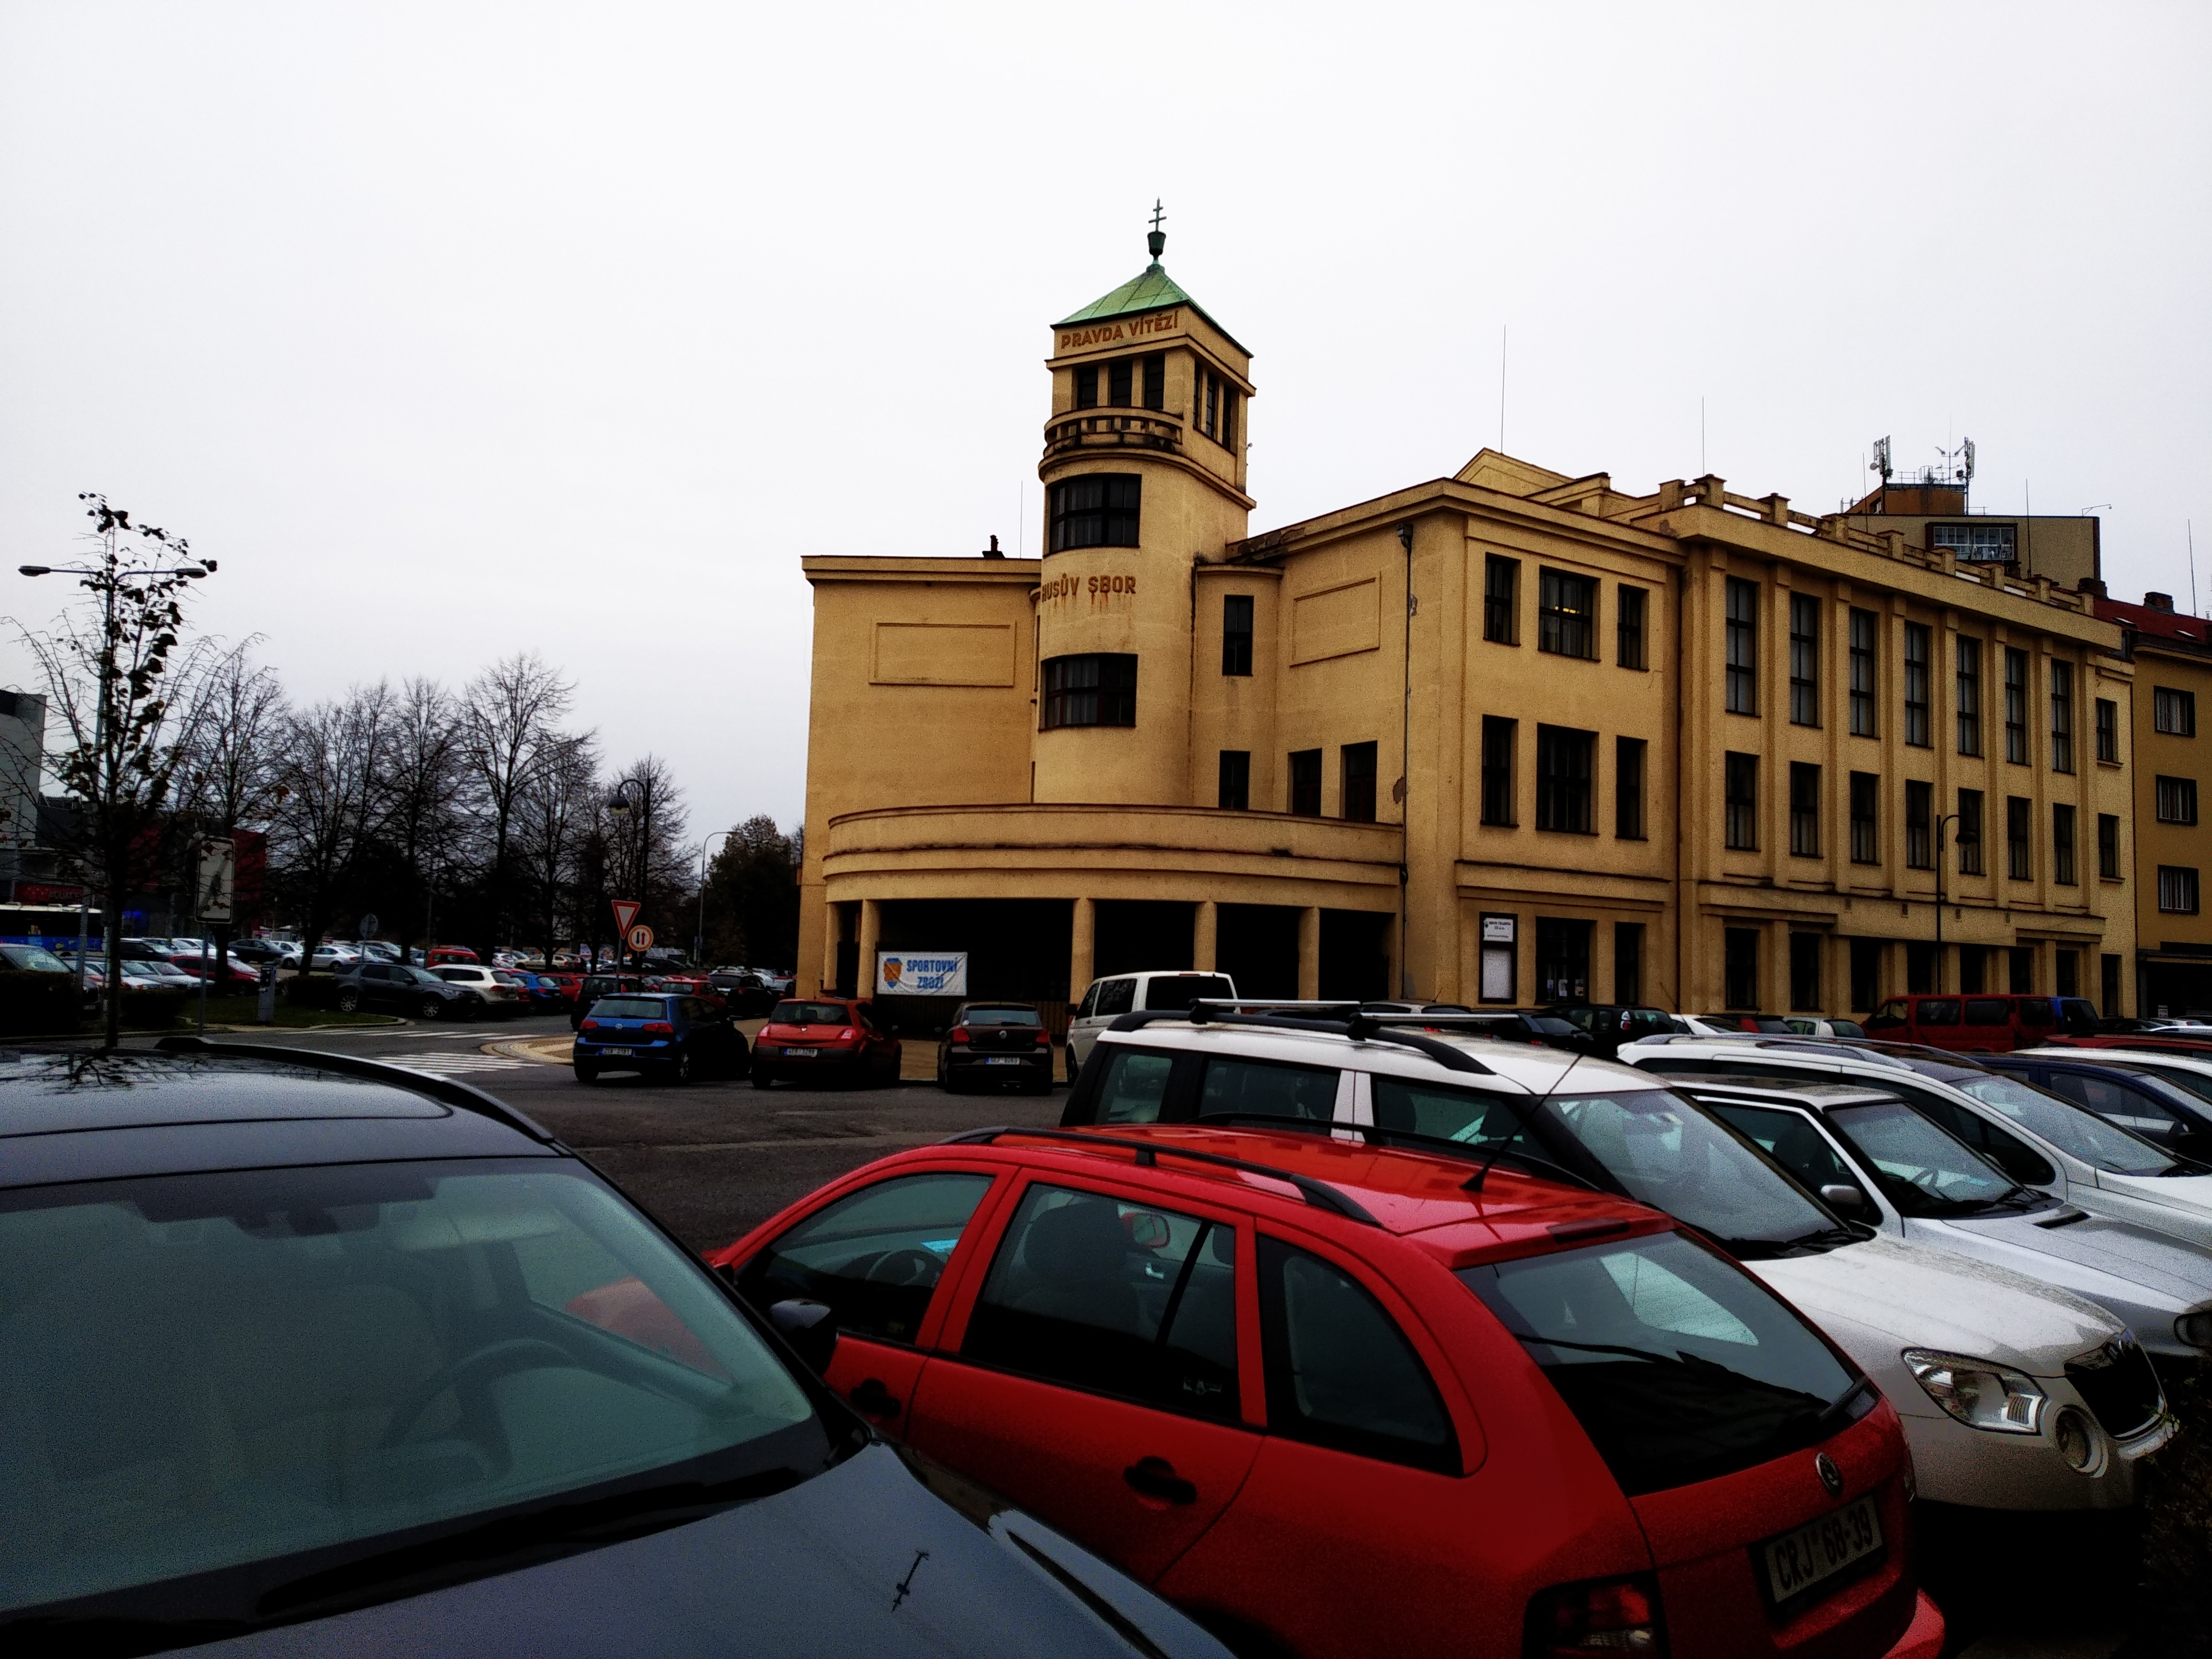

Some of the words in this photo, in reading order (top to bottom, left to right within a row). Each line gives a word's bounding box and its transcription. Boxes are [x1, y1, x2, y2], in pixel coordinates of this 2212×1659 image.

[1061, 325, 1124, 349] PRAVDA
[1128, 310, 1178, 336] VÍTĚZÍ
[1041, 573, 1079, 603] HUSŮV
[1088, 575, 1136, 594] SBOR
[906, 957, 958, 972] SPORTOVNÍ
[1774, 1532, 1814, 1590] CRJ
[1822, 1504, 1874, 1566] 68-39
